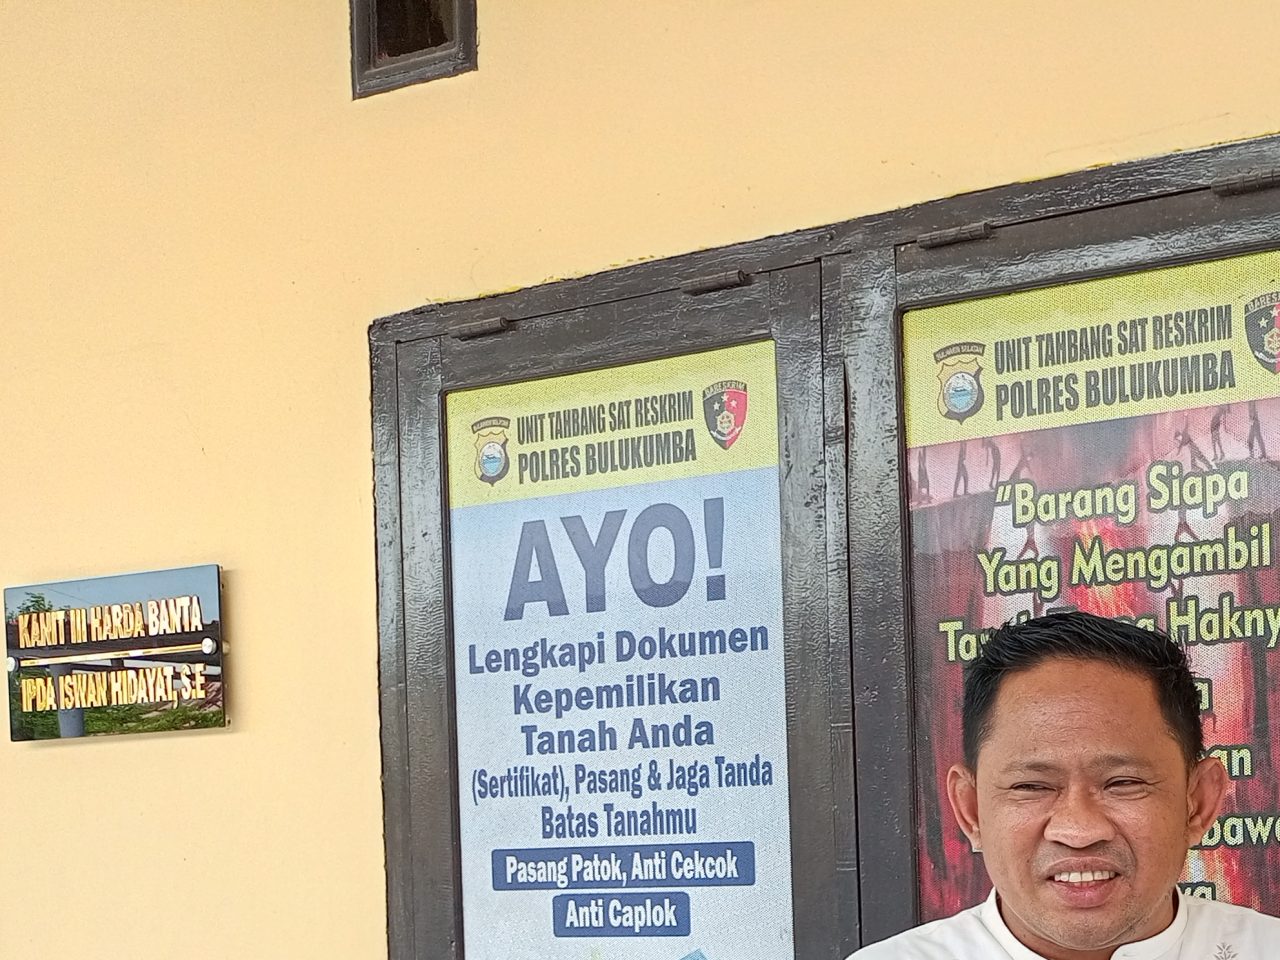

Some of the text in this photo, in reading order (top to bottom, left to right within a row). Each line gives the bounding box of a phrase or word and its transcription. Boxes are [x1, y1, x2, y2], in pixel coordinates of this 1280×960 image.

[995, 336, 1032, 374] UNIT
[1035, 323, 1113, 368] TAHBANG
[1117, 317, 1148, 355] SAT
[1152, 304, 1232, 350] RESKRIM
[996, 350, 1235, 421] POLRES BULUKUMBA
[517, 413, 545, 445] UNIT
[548, 404, 606, 440] TAHBANG
[609, 400, 632, 432] SAT
[634, 390, 693, 427] RESKRIM
[518, 429, 697, 484] POLRES BULUKUMBA
[996, 461, 1249, 524] "Barang Siapa
[504, 497, 726, 621] AYO!
[977, 523, 1271, 598] Yang Mengambil
[18, 595, 203, 648] KANIT III HARDA BANTA
[469, 625, 769, 677] Lengkapi Dokumen
[21, 677, 57, 712] IPDA
[59, 671, 108, 709] ISWAN
[109, 666, 178, 709] HIDAYAT,
[513, 674, 720, 718] Kepemilikan
[521, 715, 715, 755] Tanah Anda
[472, 754, 773, 805] (Sertifikat), Pasang & Jaga Tanda
[541, 801, 697, 839] Batas Tanahmu
[506, 849, 738, 887] Pasang Patok, Anti Cekcok
[565, 898, 677, 932] Anti Caplok
